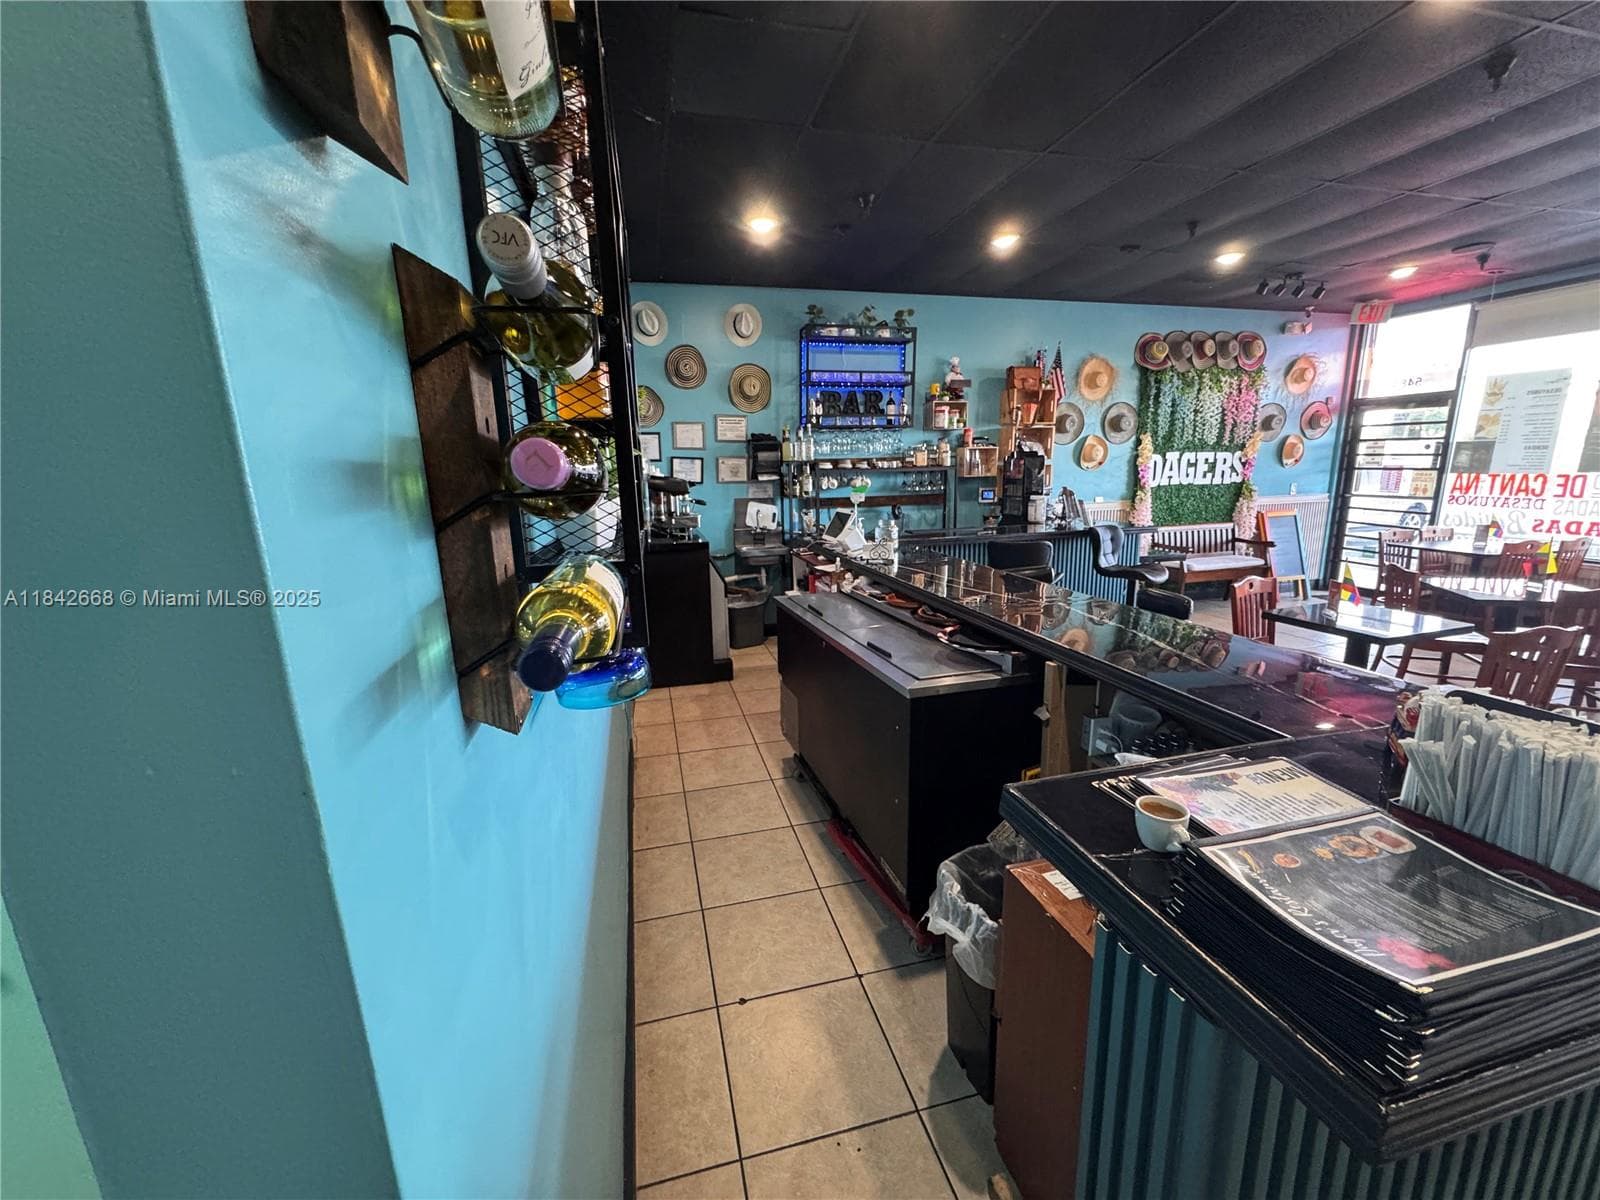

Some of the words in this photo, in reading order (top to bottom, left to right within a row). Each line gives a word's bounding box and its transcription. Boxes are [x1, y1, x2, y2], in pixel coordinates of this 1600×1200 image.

[491, 229, 519, 247] VFC
[820, 390, 884, 415] BAR
[1149, 451, 1244, 487] DAGERS
[1253, 766, 1309, 785] MENU
